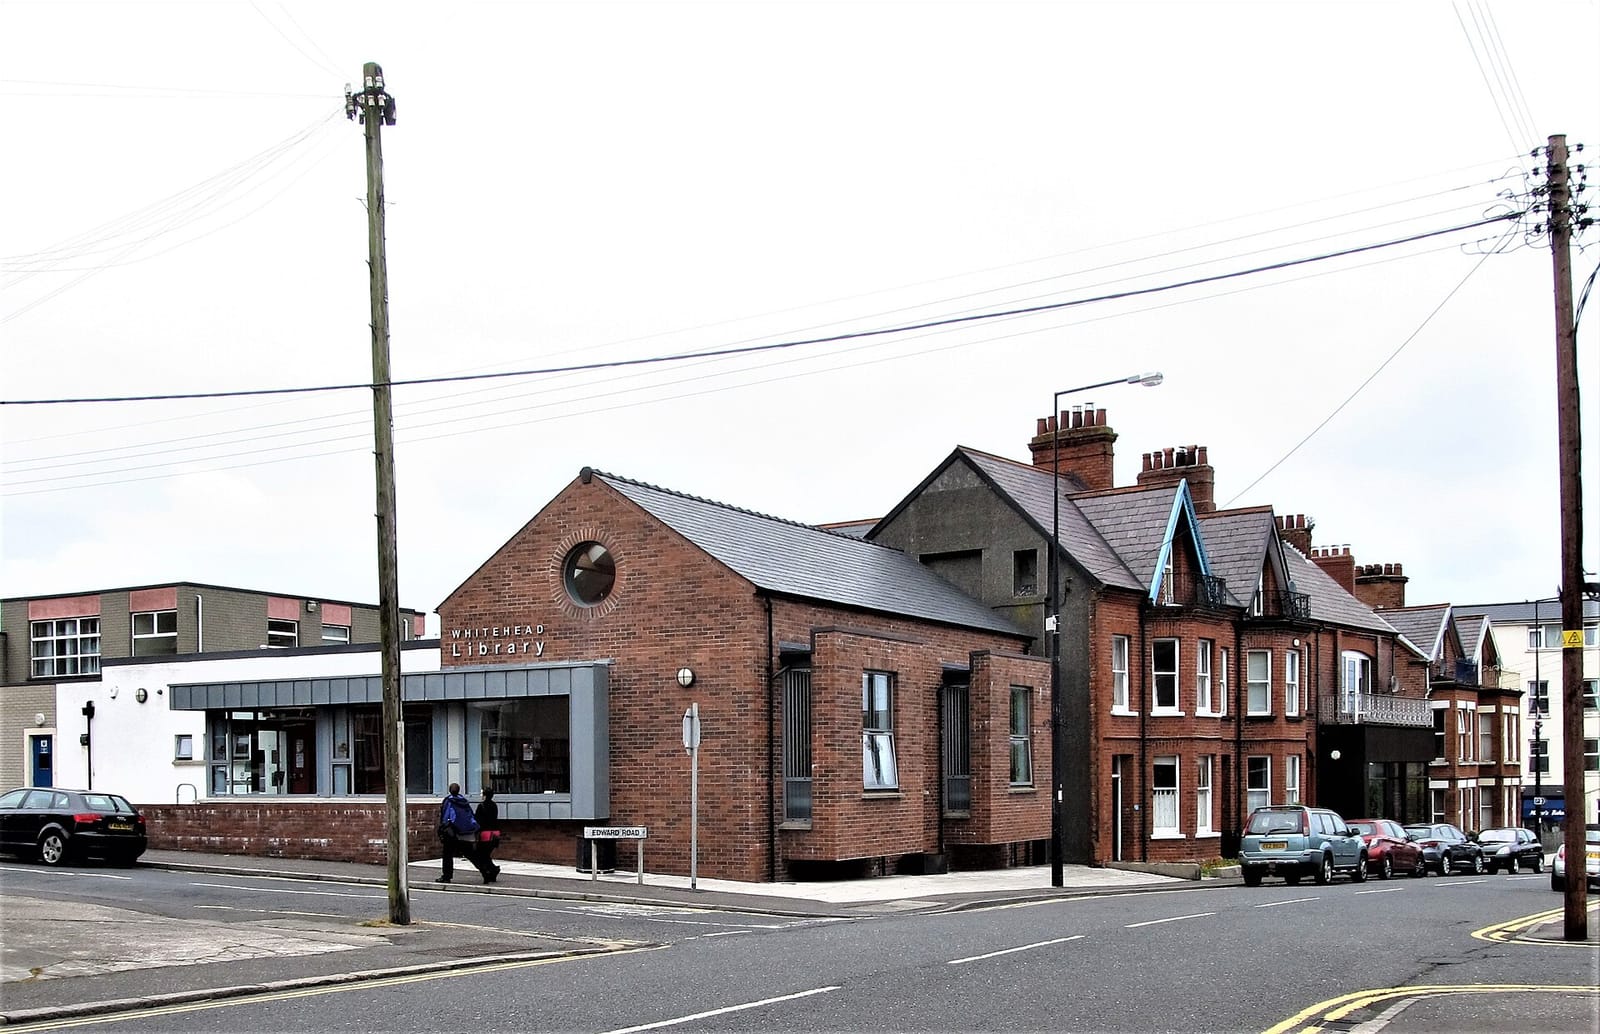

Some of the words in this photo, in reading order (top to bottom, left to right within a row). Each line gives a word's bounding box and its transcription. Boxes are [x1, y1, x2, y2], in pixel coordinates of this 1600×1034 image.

[452, 624, 544, 639] WHITEHEAD
[452, 641, 545, 657] Library
[591, 829, 620, 837] EDWARD
[621, 829, 640, 837] ROAD
